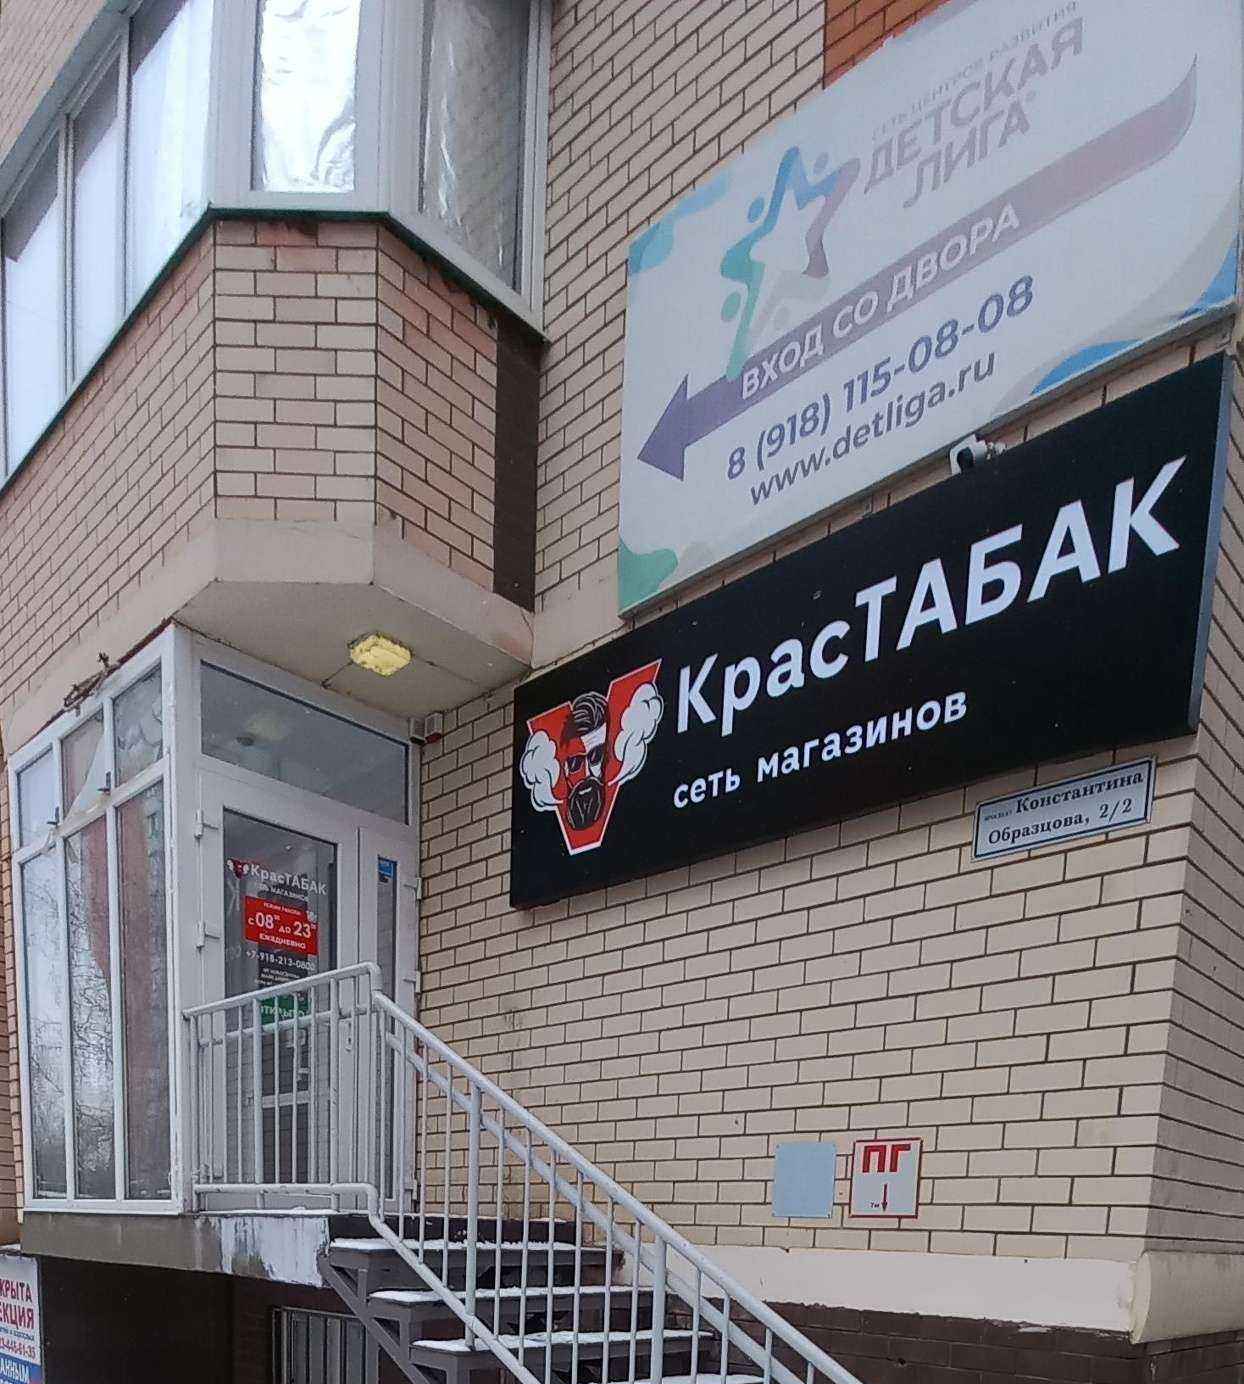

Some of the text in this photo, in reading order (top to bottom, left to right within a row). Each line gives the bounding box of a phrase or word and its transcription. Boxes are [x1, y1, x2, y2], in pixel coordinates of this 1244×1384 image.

[864, 16, 1083, 194] ДЕТСКАЯ
[903, 100, 1031, 208] ЛИГА
[742, 203, 1021, 400] ВХОД СО ДВОРА
[727, 274, 1034, 480] 8 (918) 115-08-08
[750, 351, 995, 505] www.detliga.ru
[677, 455, 1187, 737] КрасТАБАК
[673, 691, 967, 809] сеть магазинов
[1016, 771, 1144, 815] Константина
[251, 864, 327, 895] КрасТАБАК
[988, 813, 1090, 845] Образцова,
[1099, 798, 1133, 823] 2/2
[861, 1143, 912, 1174] ПГ
